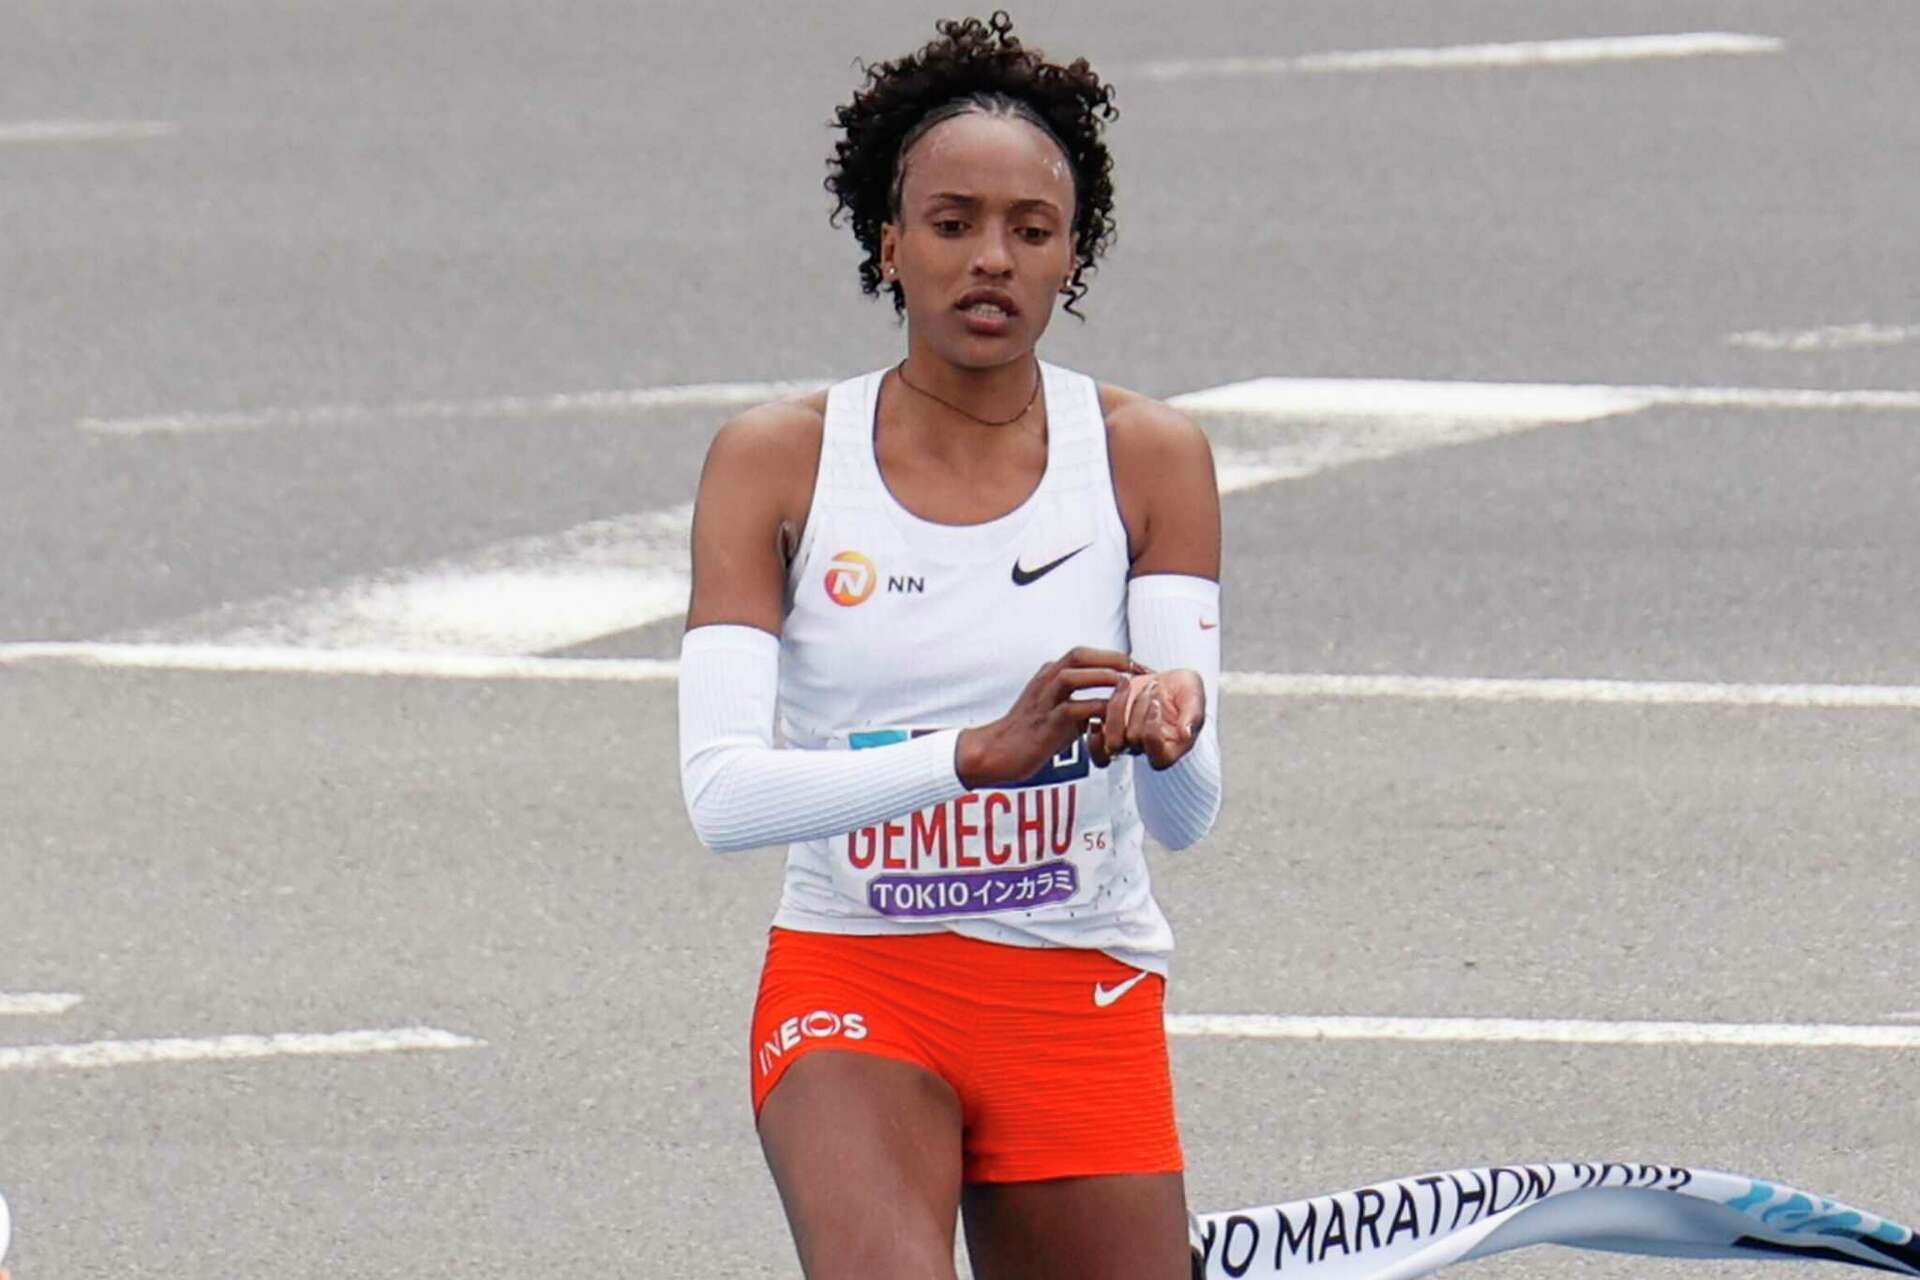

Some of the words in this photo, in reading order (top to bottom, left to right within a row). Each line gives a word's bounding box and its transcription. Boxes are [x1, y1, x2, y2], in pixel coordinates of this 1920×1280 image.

[887, 575, 924, 593] NN
[848, 784, 1076, 869] GEMECHU
[1083, 832, 1106, 851] 56
[759, 1010, 868, 1077] INEOS
[1274, 1164, 1556, 1271] MARATHON
